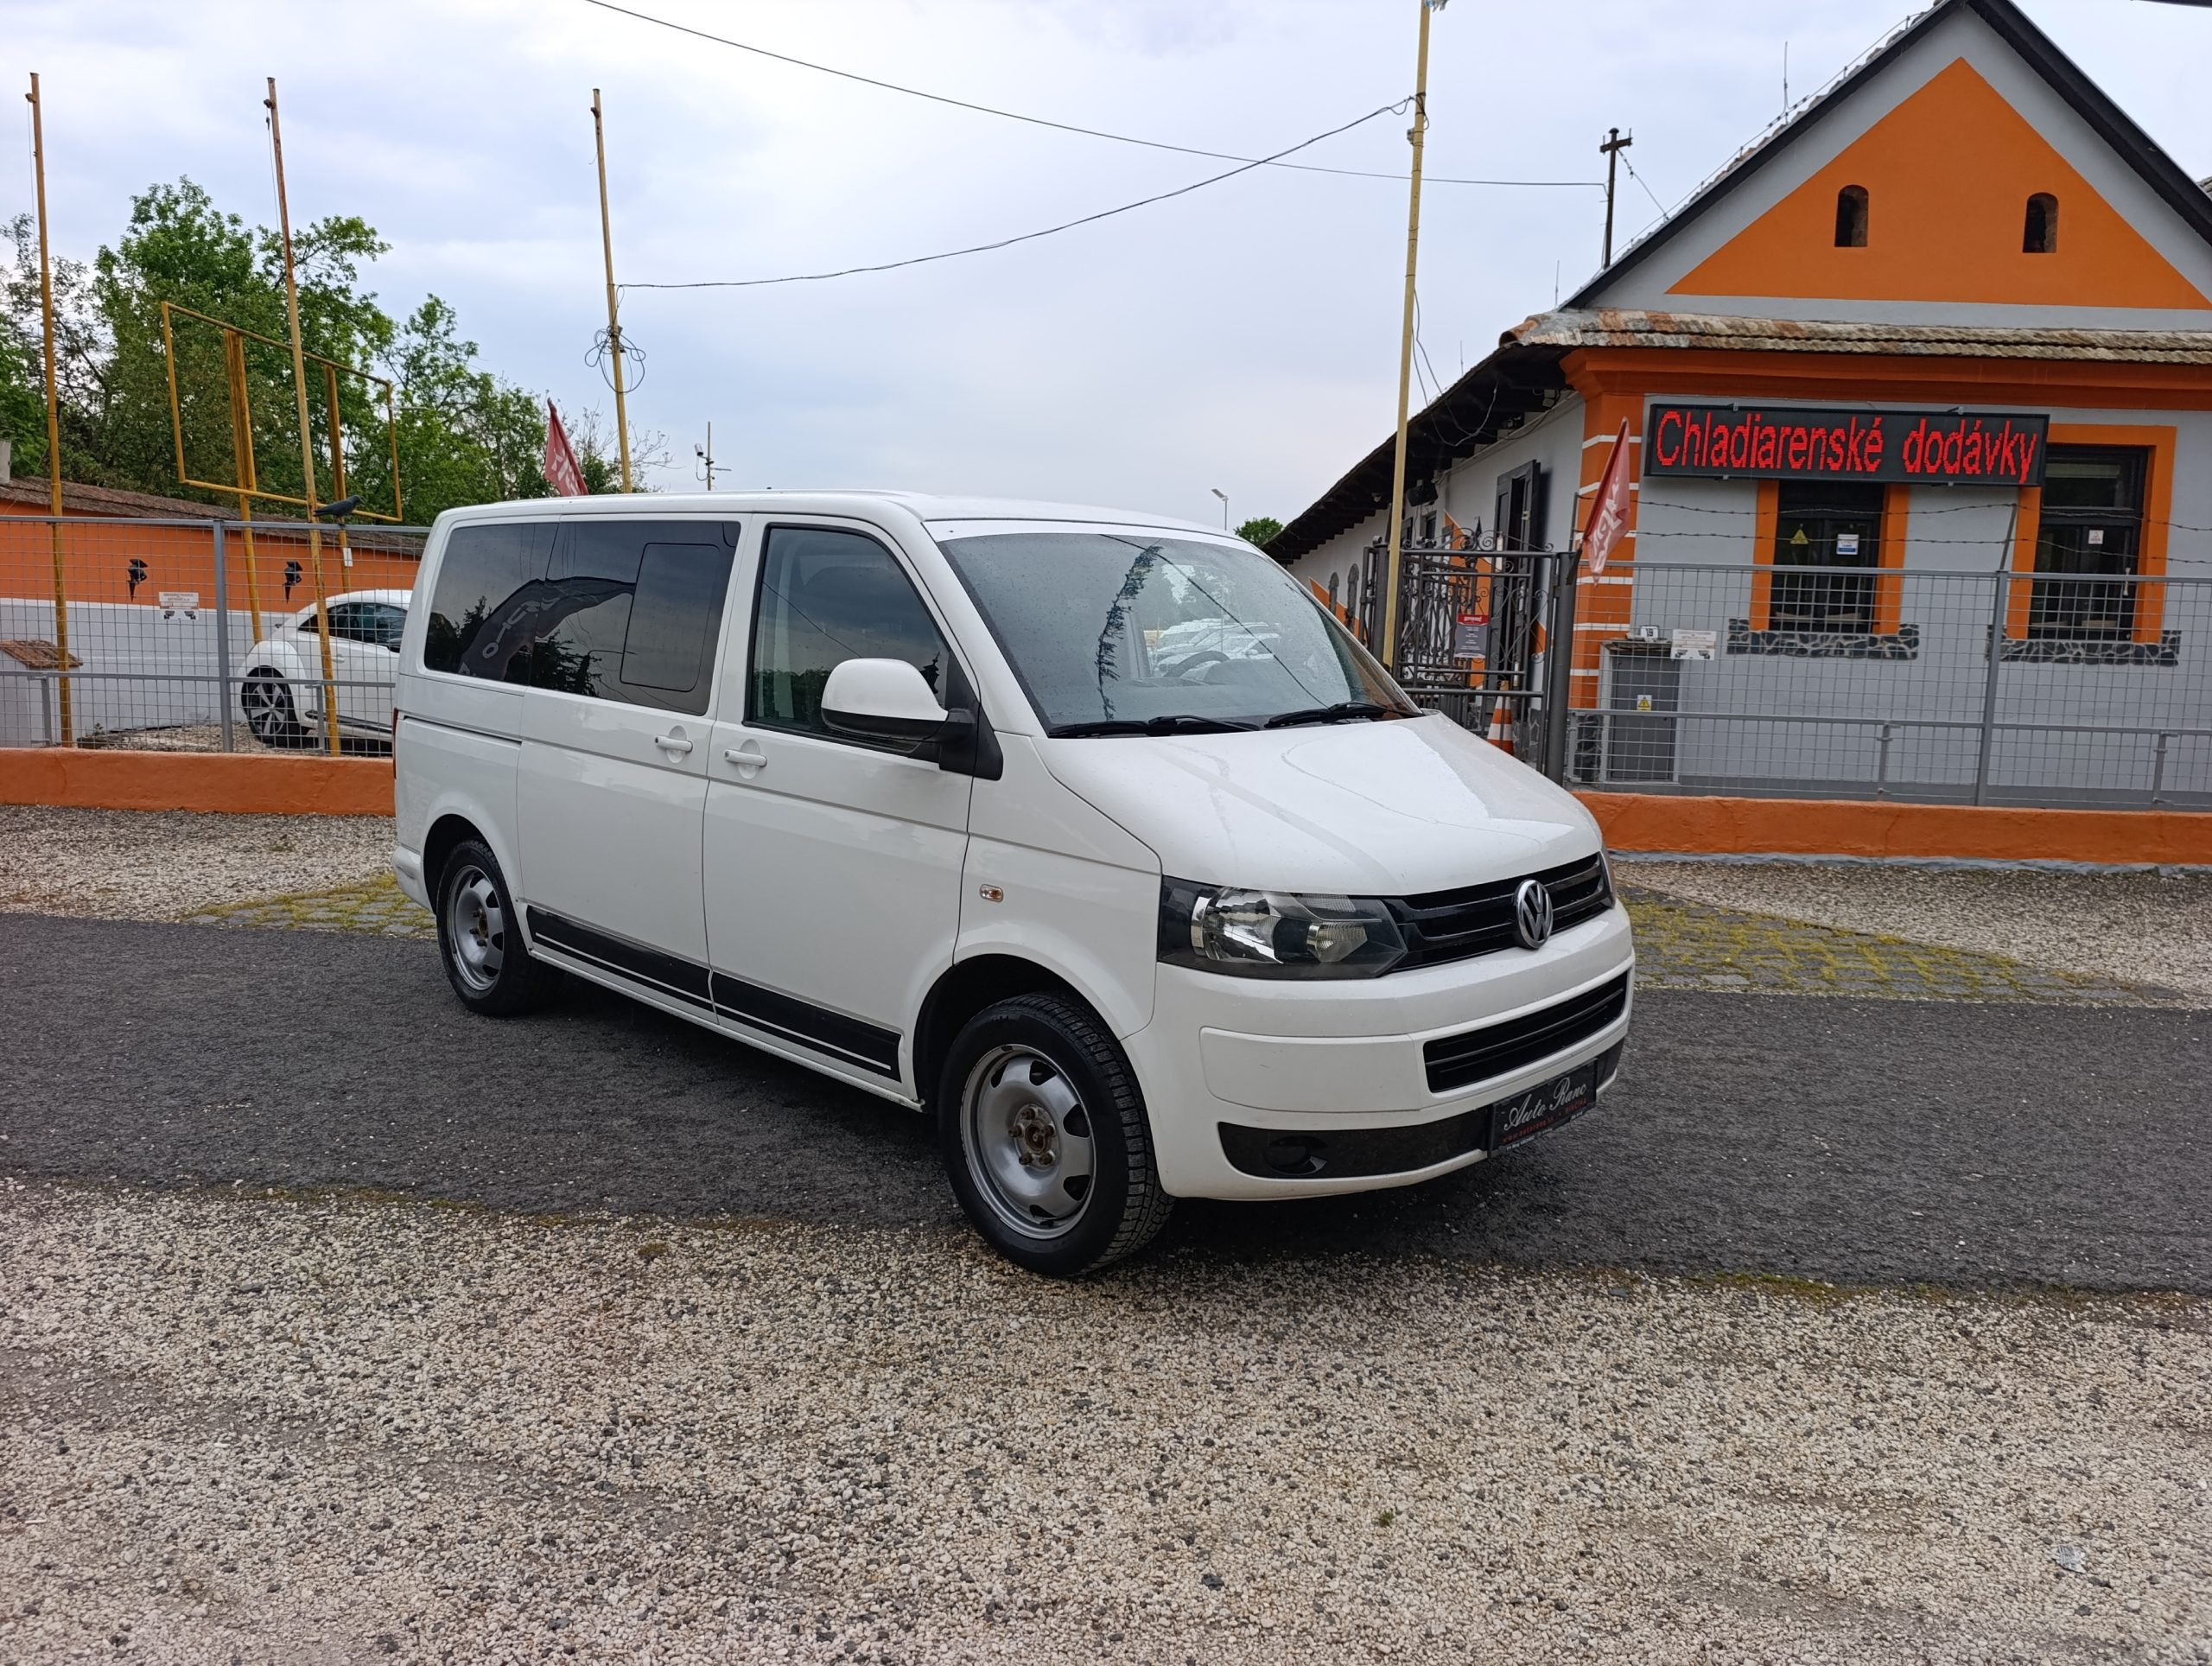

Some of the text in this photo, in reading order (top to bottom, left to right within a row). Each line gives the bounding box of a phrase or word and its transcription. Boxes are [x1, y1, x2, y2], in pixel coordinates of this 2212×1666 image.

[1656, 410, 2037, 485] Chladiarenské dodávky
[1503, 1093, 1547, 1131] Auto
